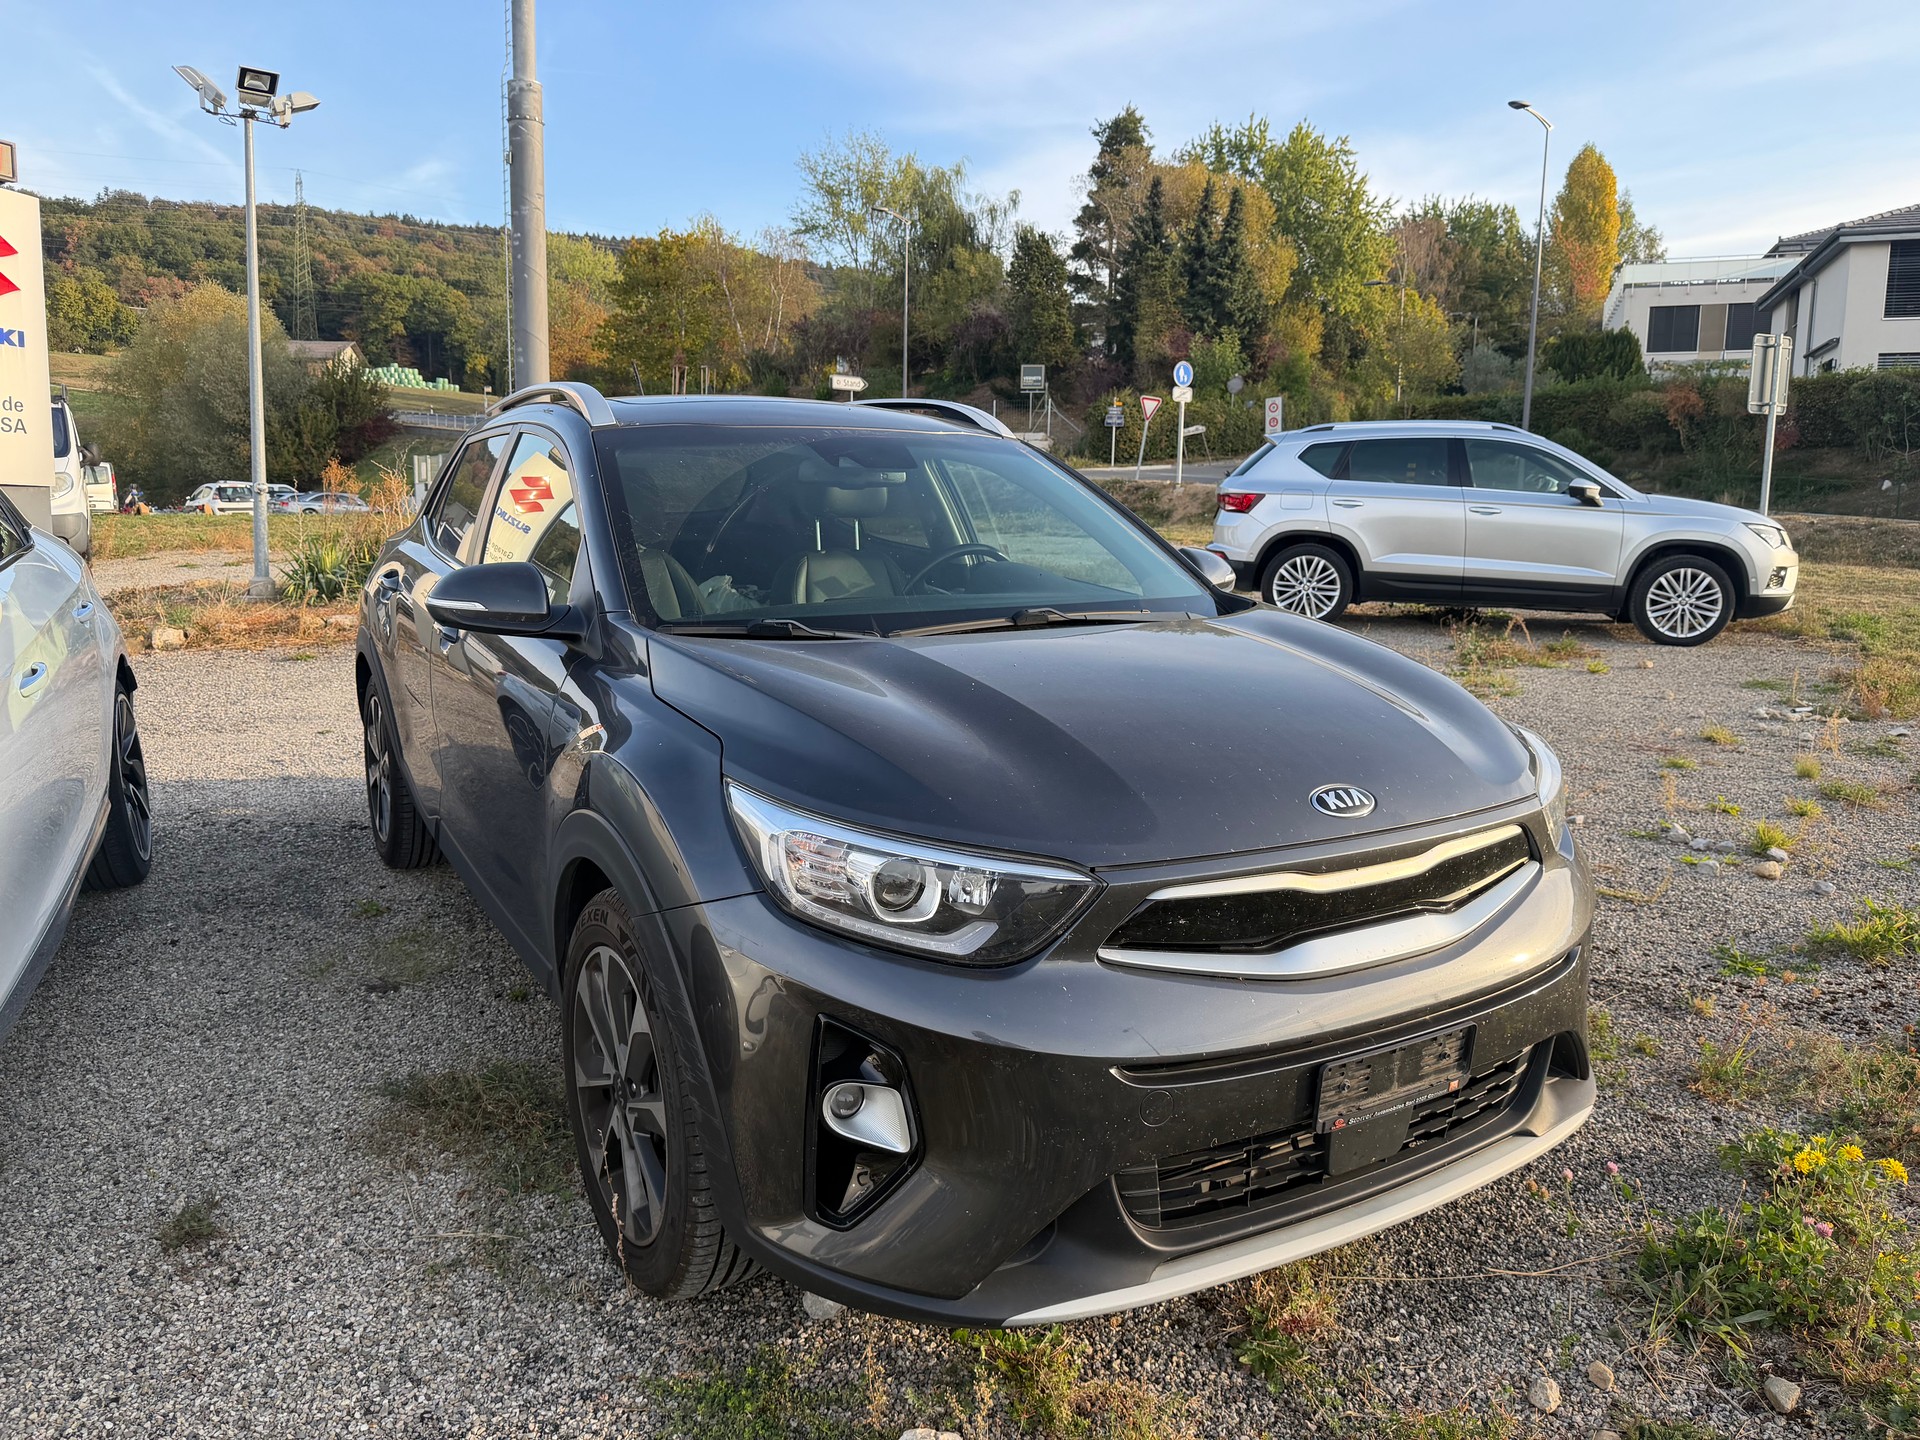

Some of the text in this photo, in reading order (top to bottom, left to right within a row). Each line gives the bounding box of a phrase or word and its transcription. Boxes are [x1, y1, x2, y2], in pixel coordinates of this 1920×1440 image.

[2, 396, 24, 412] de
[0, 417, 27, 434] SA
[1319, 788, 1370, 810] KIA
